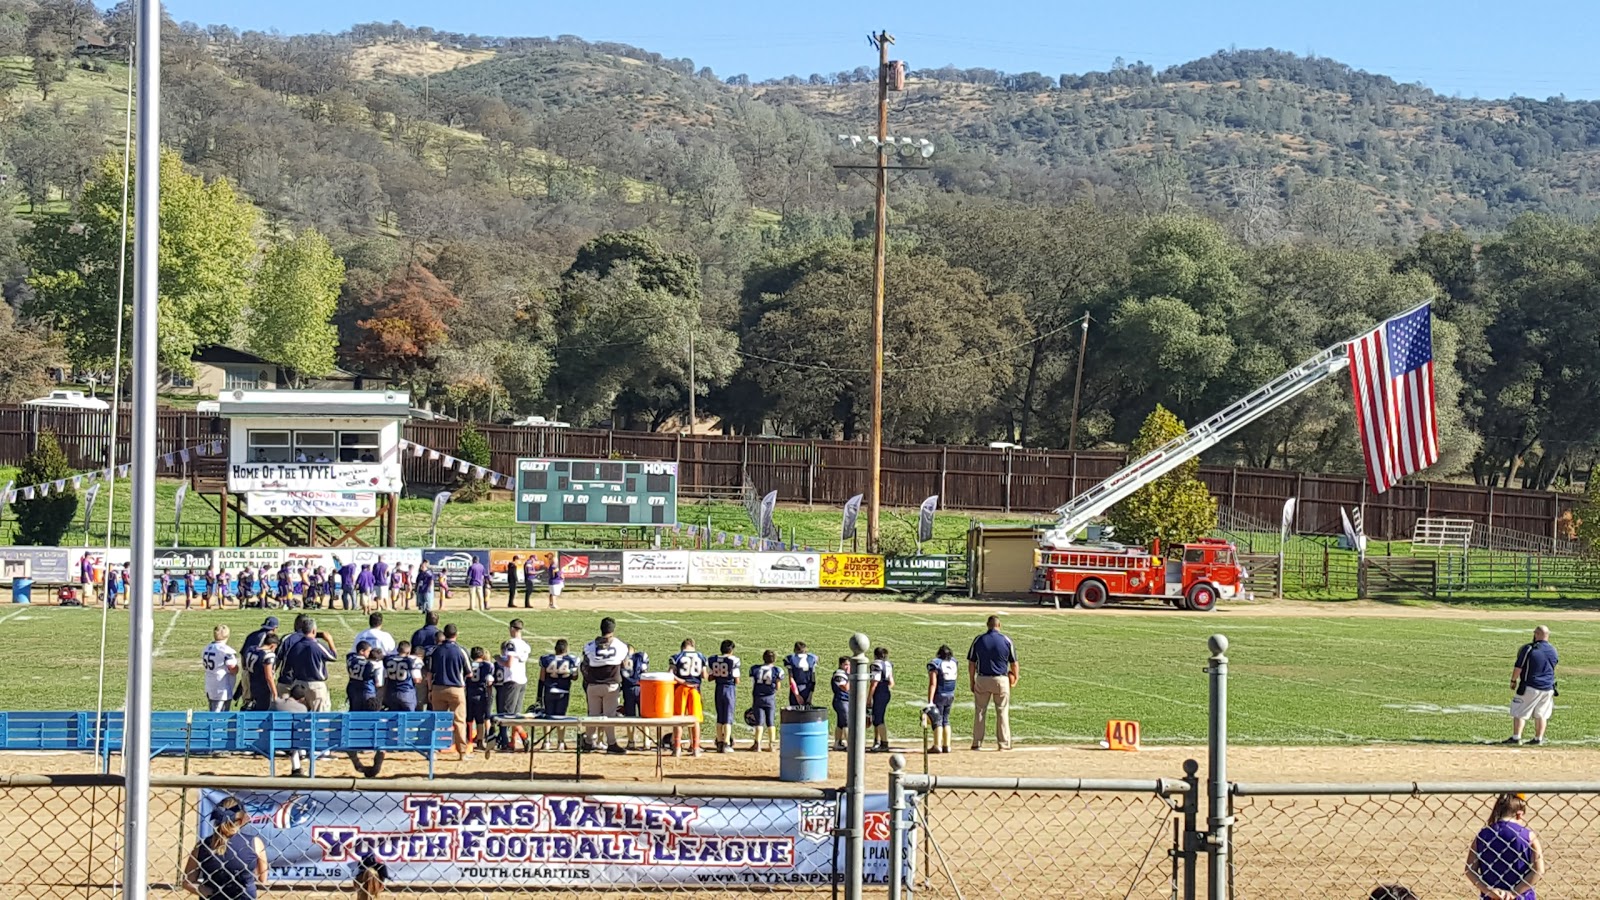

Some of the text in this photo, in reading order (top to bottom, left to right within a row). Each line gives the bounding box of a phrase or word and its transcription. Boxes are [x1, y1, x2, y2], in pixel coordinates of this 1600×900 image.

[233, 465, 337, 479] HOME OF THE TVYFL
[520, 462, 550, 471] GUEST
[644, 463, 676, 475] HOME
[522, 494, 547, 503] DOWN
[563, 494, 589, 504] TO GO
[601, 495, 638, 504] BALL ON
[186, 553, 211, 568] Bank
[844, 563, 878, 571] BURGER
[886, 559, 946, 569] H & L LUMBER
[758, 568, 816, 580] YOSEMITE
[203, 651, 216, 671] 55
[246, 652, 259, 673] 17
[680, 656, 702, 677] 38
[387, 660, 409, 681] 26
[546, 660, 571, 678] 44
[712, 662, 729, 678] 88
[757, 666, 773, 685] 14
[1113, 721, 1137, 746] 40
[407, 798, 695, 832] TRANS VALLEY
[316, 829, 790, 863] YOUTH FOOTBALL LEAGUE
[868, 846, 908, 860] PLAYS
[459, 867, 591, 879] YOUTH CHARITIES
